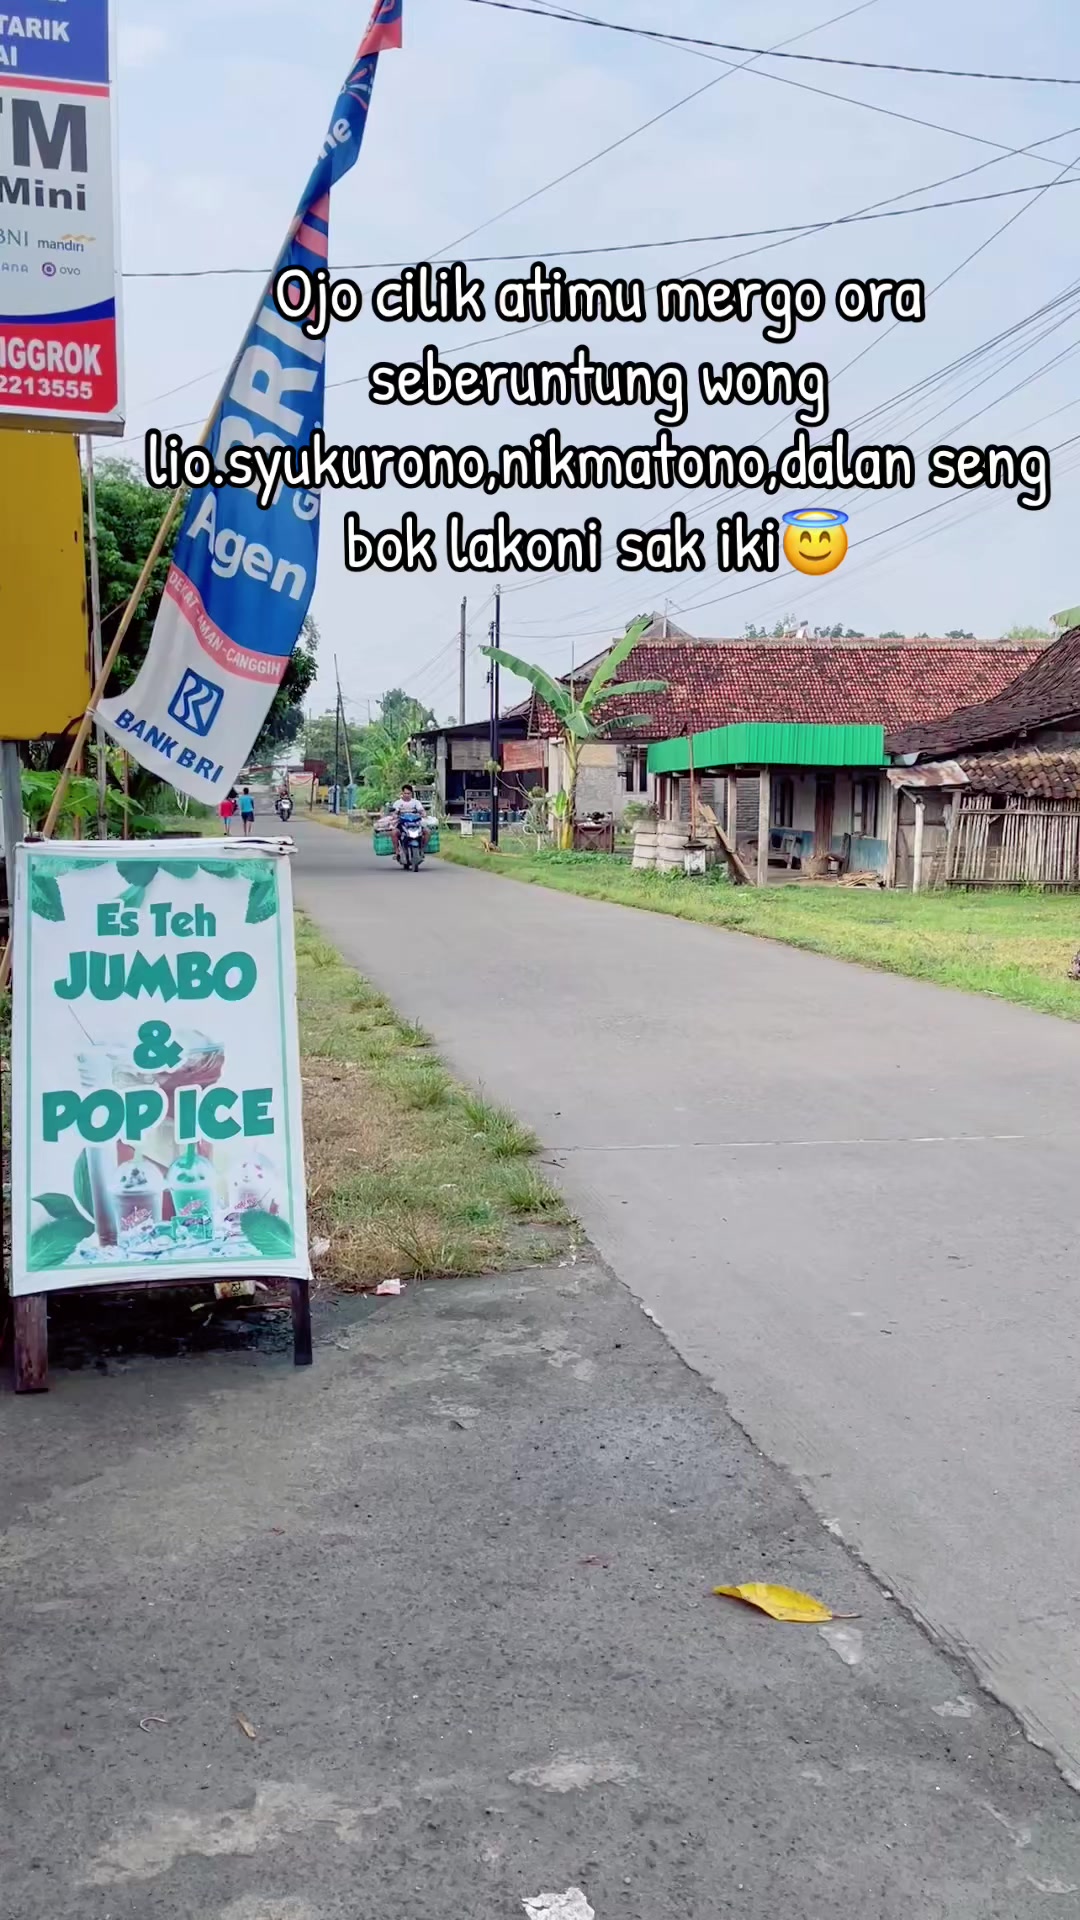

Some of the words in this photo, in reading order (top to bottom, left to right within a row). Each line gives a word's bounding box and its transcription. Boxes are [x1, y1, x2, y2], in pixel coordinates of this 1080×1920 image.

[0, 96, 88, 173] M
[0, 175, 87, 211] Mini
[186, 491, 307, 601] Agen
[226, 647, 281, 676] CANGGIH
[114, 708, 180, 760] BANK
[175, 746, 224, 784] BRI
[97, 902, 139, 937] Es
[150, 902, 216, 937] Teh
[54, 950, 257, 1002] JUMBO
[133, 1020, 184, 1070] &
[42, 1088, 163, 1142] POP
[179, 1087, 275, 1140] ICE
